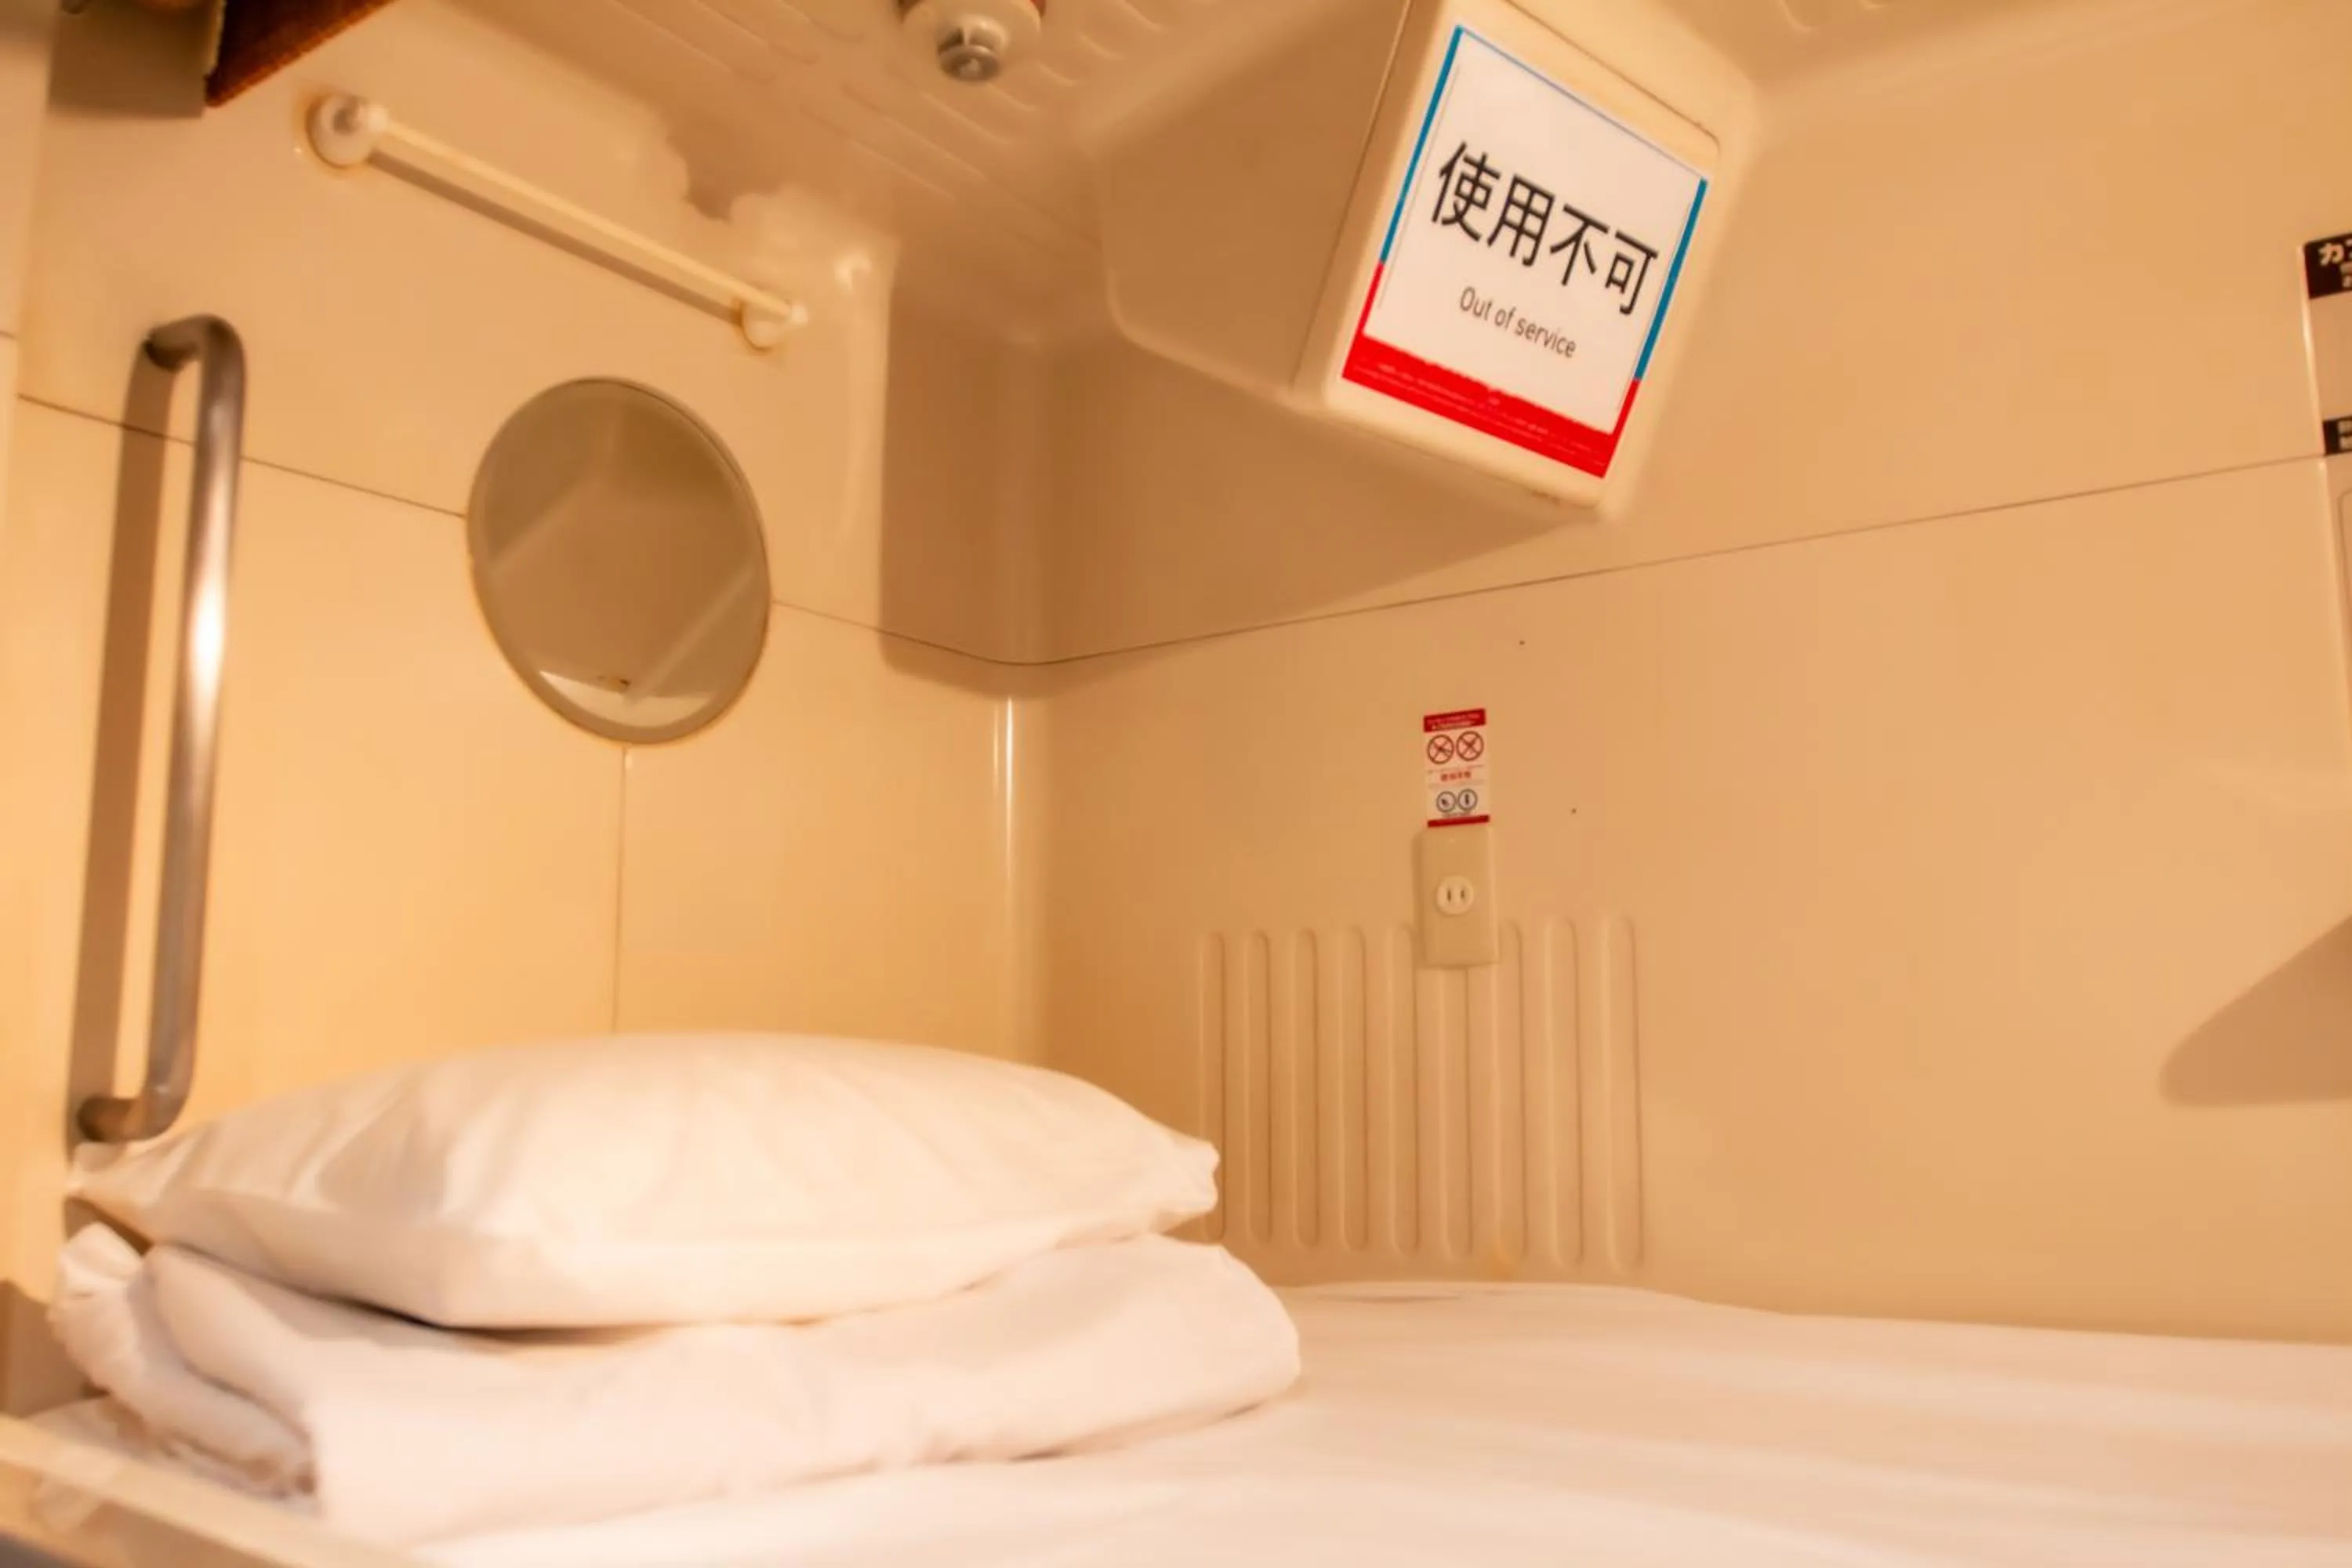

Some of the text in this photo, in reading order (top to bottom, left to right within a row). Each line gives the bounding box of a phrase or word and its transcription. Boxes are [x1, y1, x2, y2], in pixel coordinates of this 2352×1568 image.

[1430, 140, 1660, 317] 使用不可
[1459, 285, 1577, 358] Out of service
